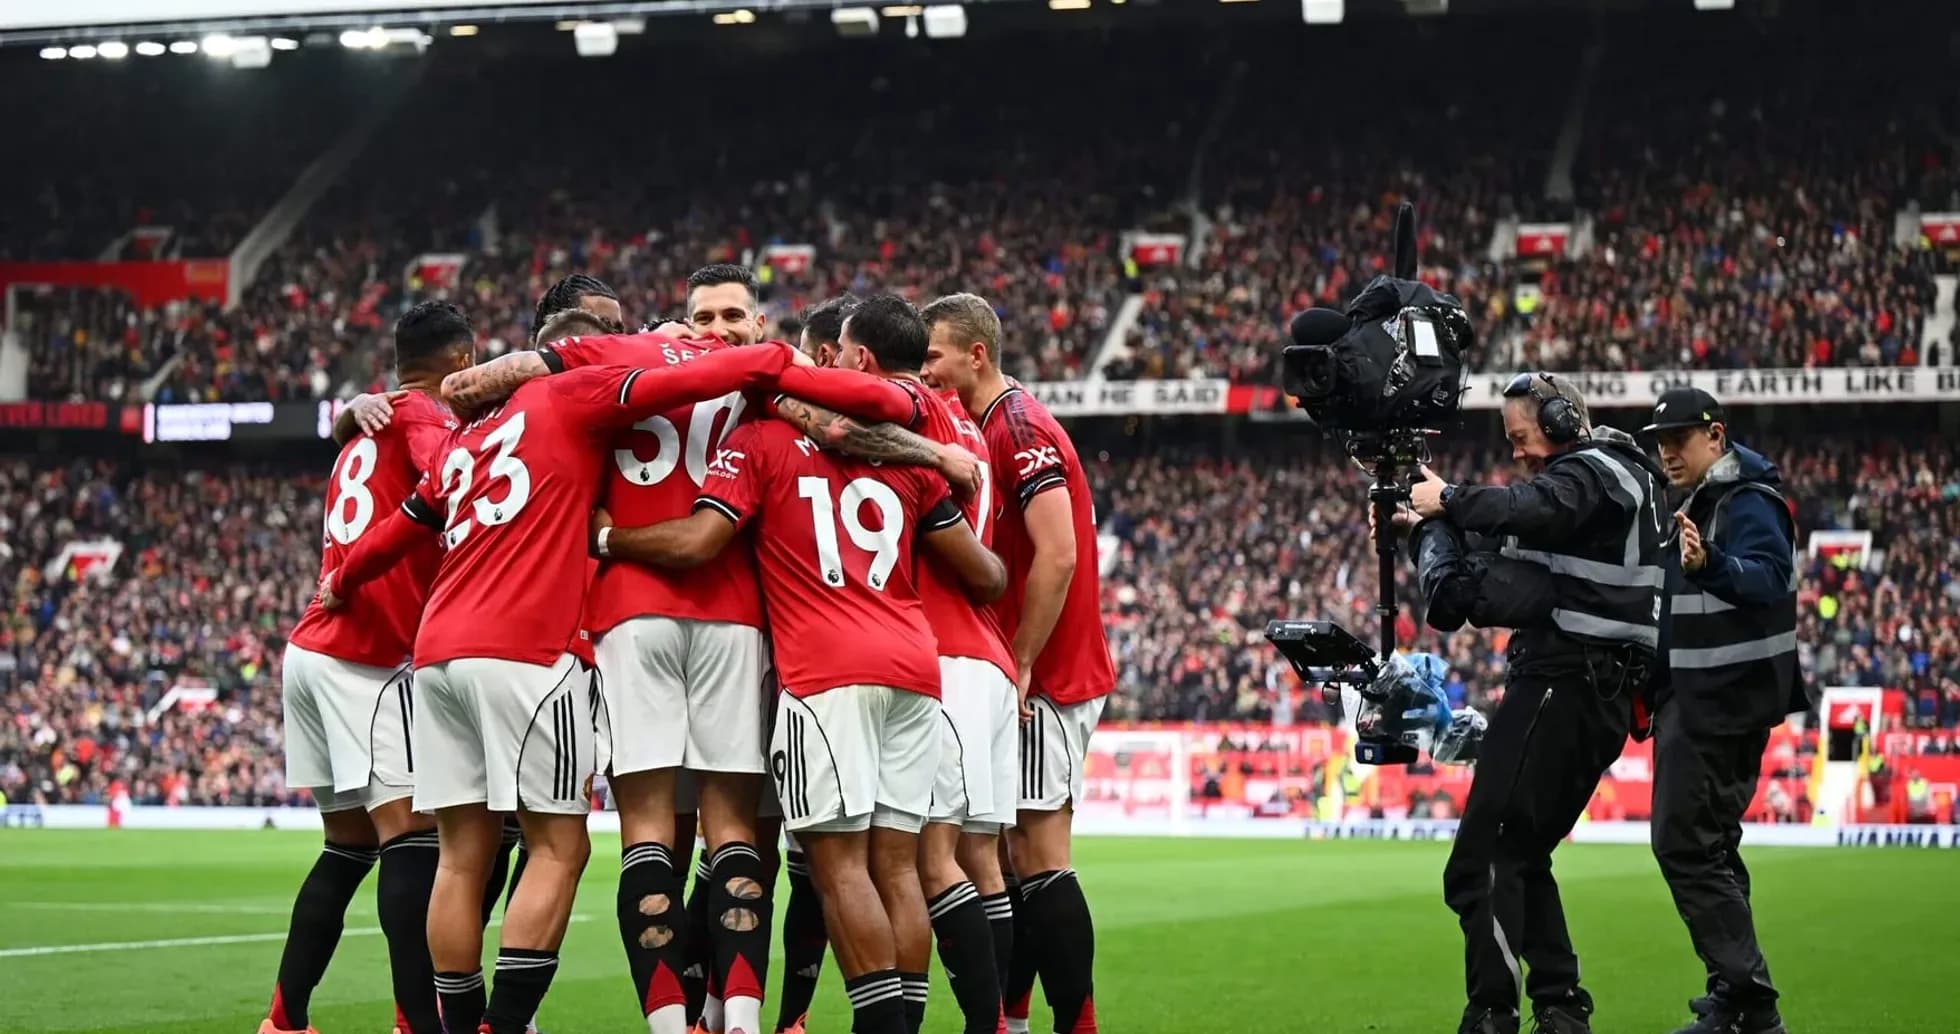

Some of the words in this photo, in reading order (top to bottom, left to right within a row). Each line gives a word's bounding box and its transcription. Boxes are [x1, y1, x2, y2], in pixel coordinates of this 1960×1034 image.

[1716, 369, 1823, 393] EARTH
[1846, 368, 1915, 393] LIKE
[322, 438, 378, 547] 8
[440, 411, 531, 551] 23
[797, 476, 905, 592] 19
